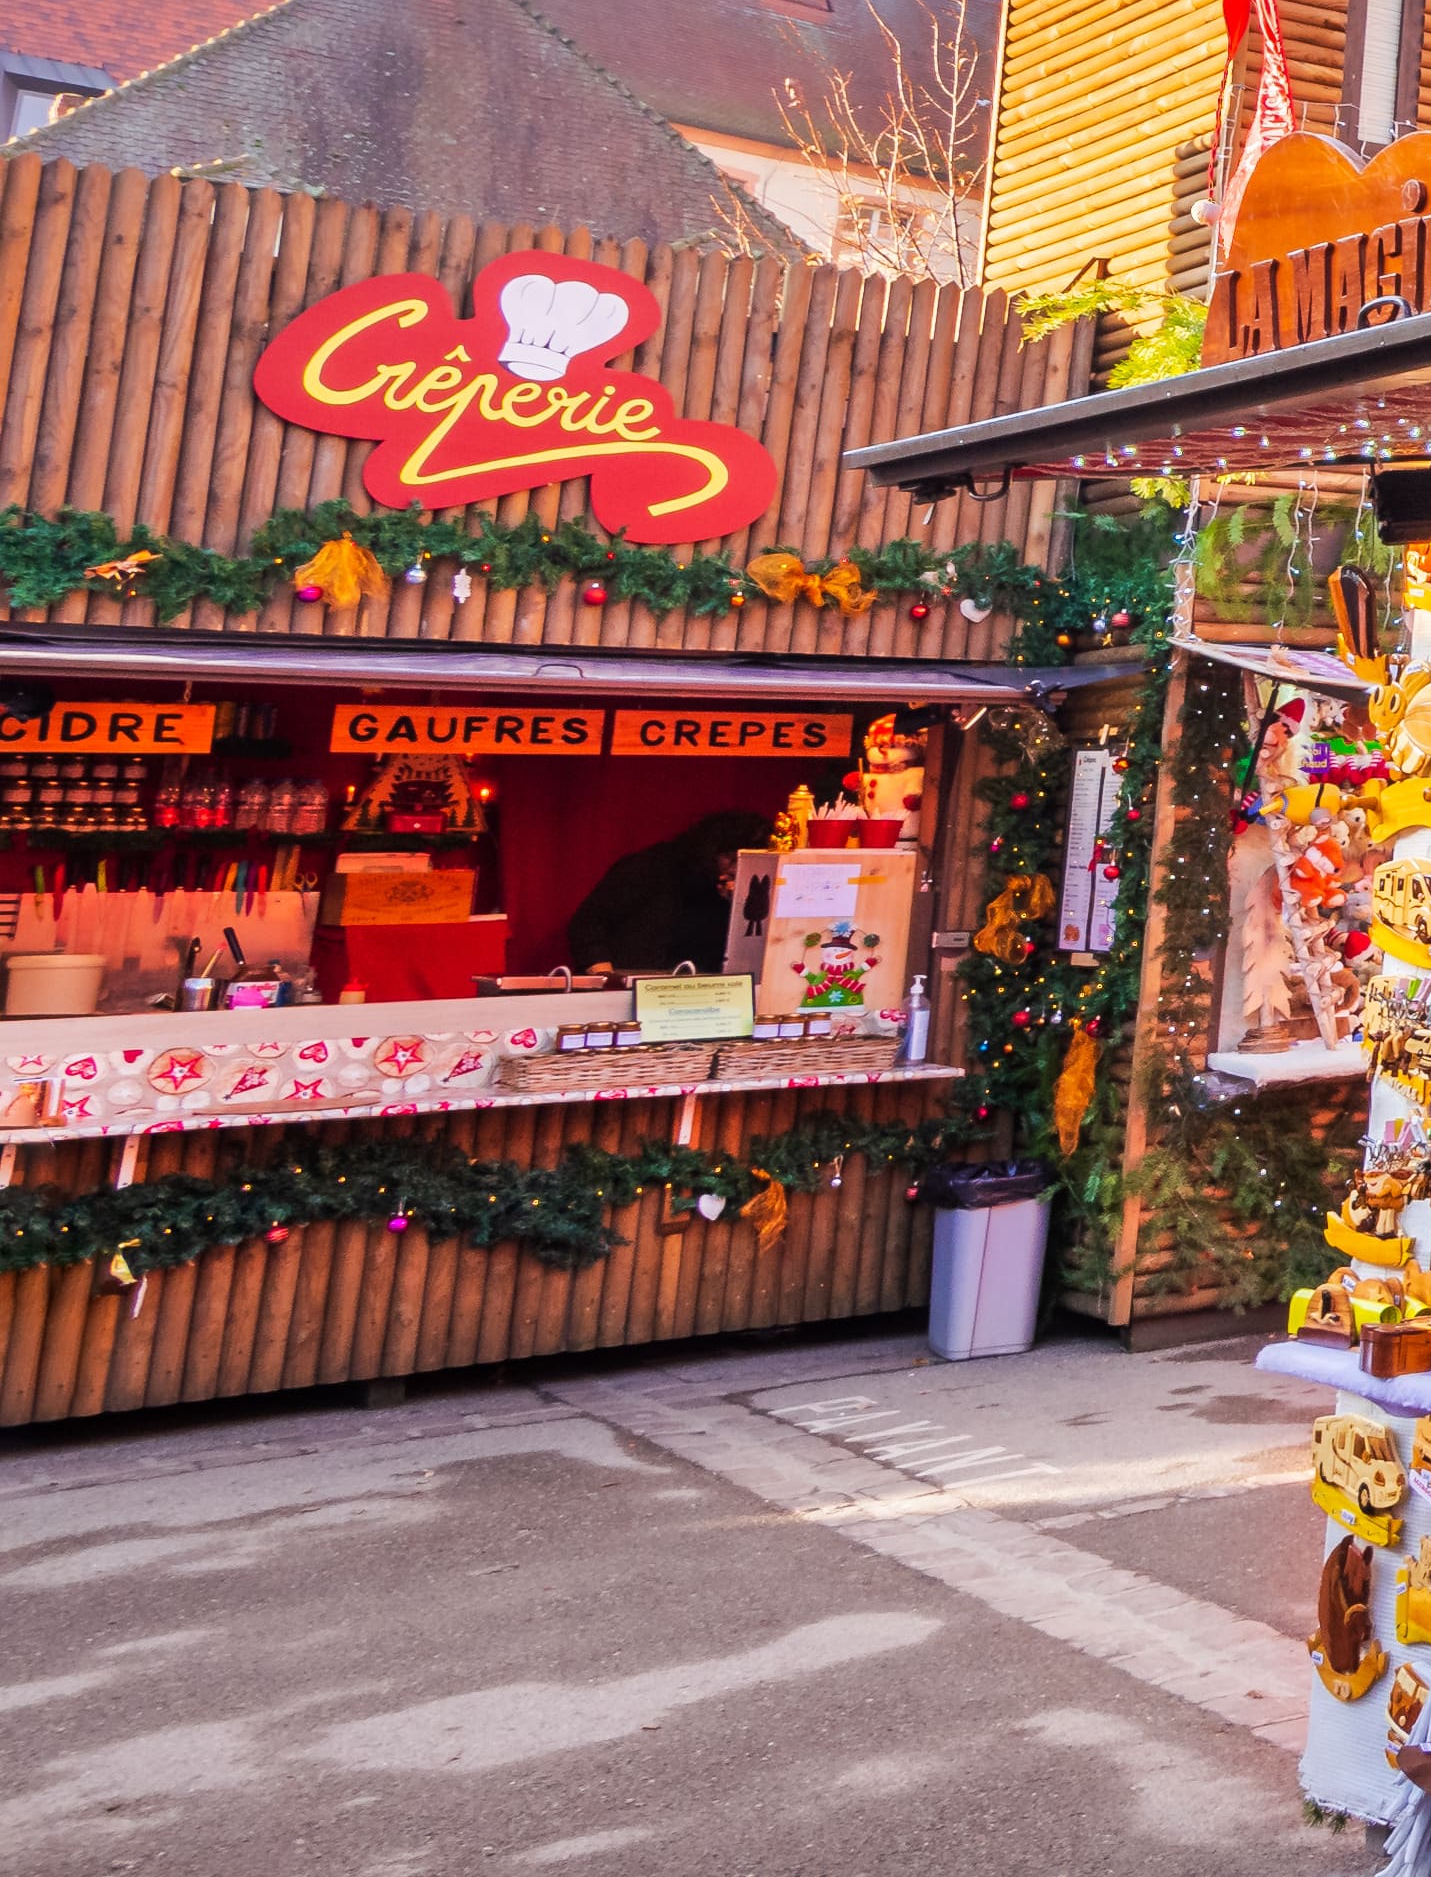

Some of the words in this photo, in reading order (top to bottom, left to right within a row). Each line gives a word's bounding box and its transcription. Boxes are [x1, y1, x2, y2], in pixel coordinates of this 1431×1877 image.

[1222, 256, 1280, 354] LA
[304, 299, 728, 516] Crêperie
[0, 711, 188, 745] CIDRE
[348, 711, 590, 745] GAUFRES
[639, 718, 828, 750] CREPES
[768, 1395, 1063, 1491] PAYANT
